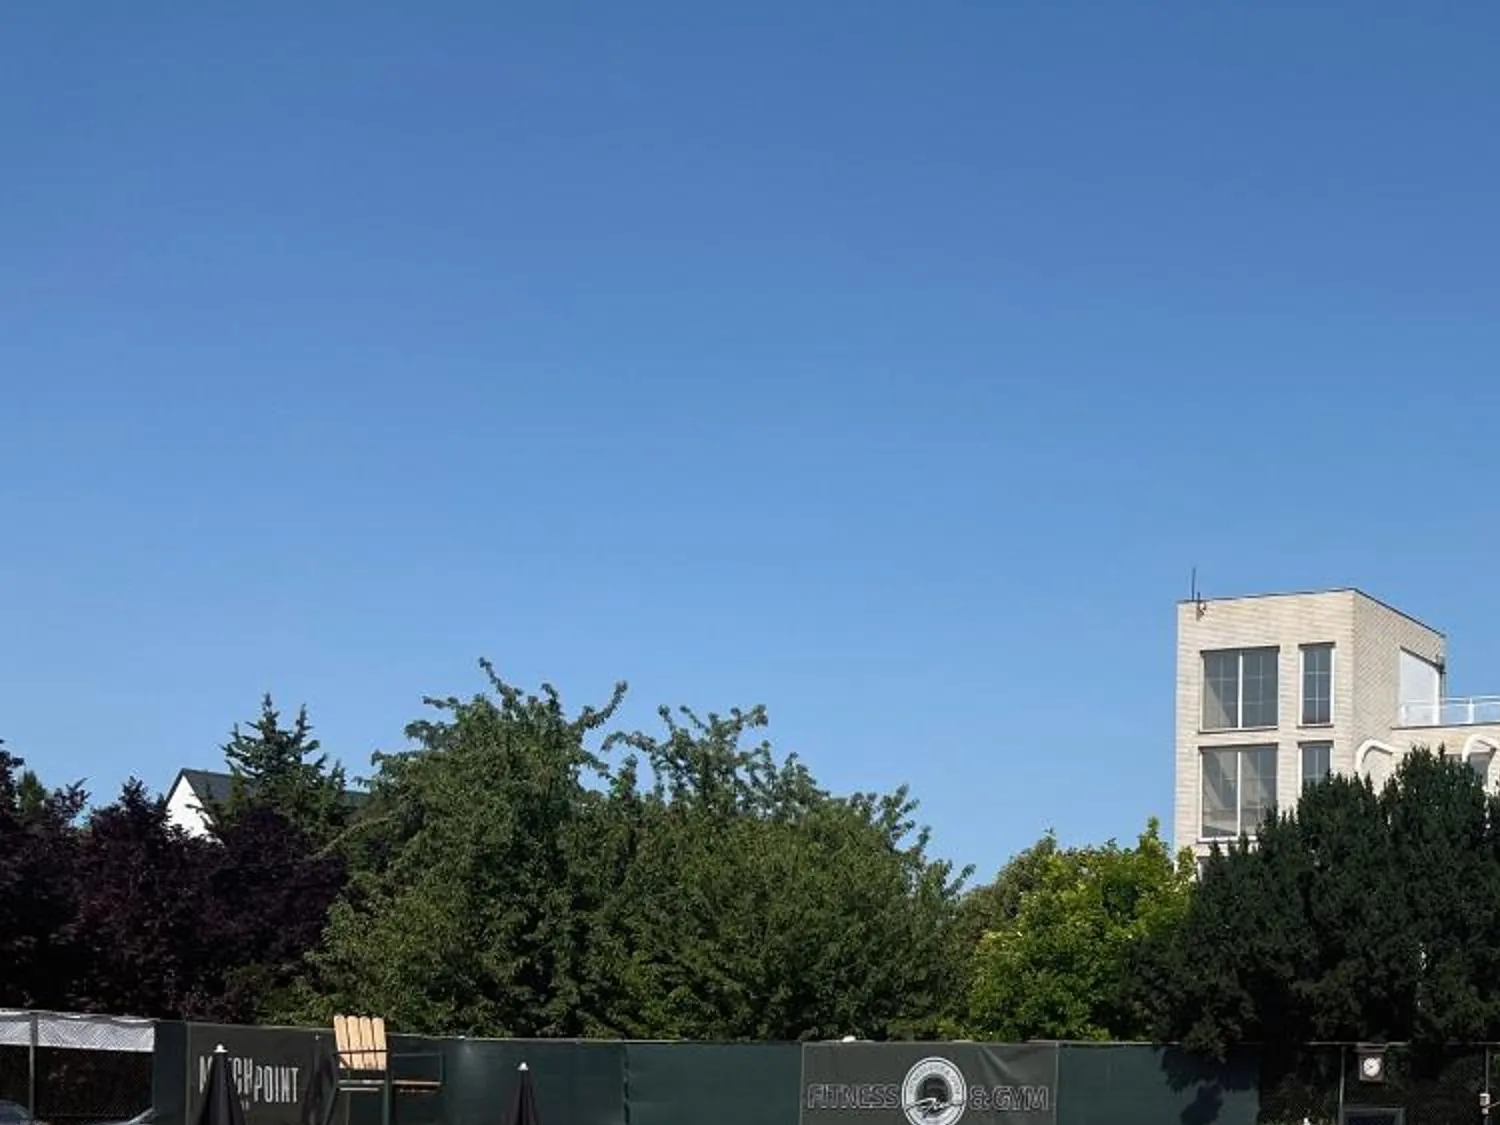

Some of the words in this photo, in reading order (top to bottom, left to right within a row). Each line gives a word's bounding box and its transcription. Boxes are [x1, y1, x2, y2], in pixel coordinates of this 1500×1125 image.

[199, 1056, 253, 1095] MCH
[253, 1065, 299, 1103] POINT
[807, 1083, 900, 1110] FITNESS
[992, 1085, 1050, 1112] GYM
